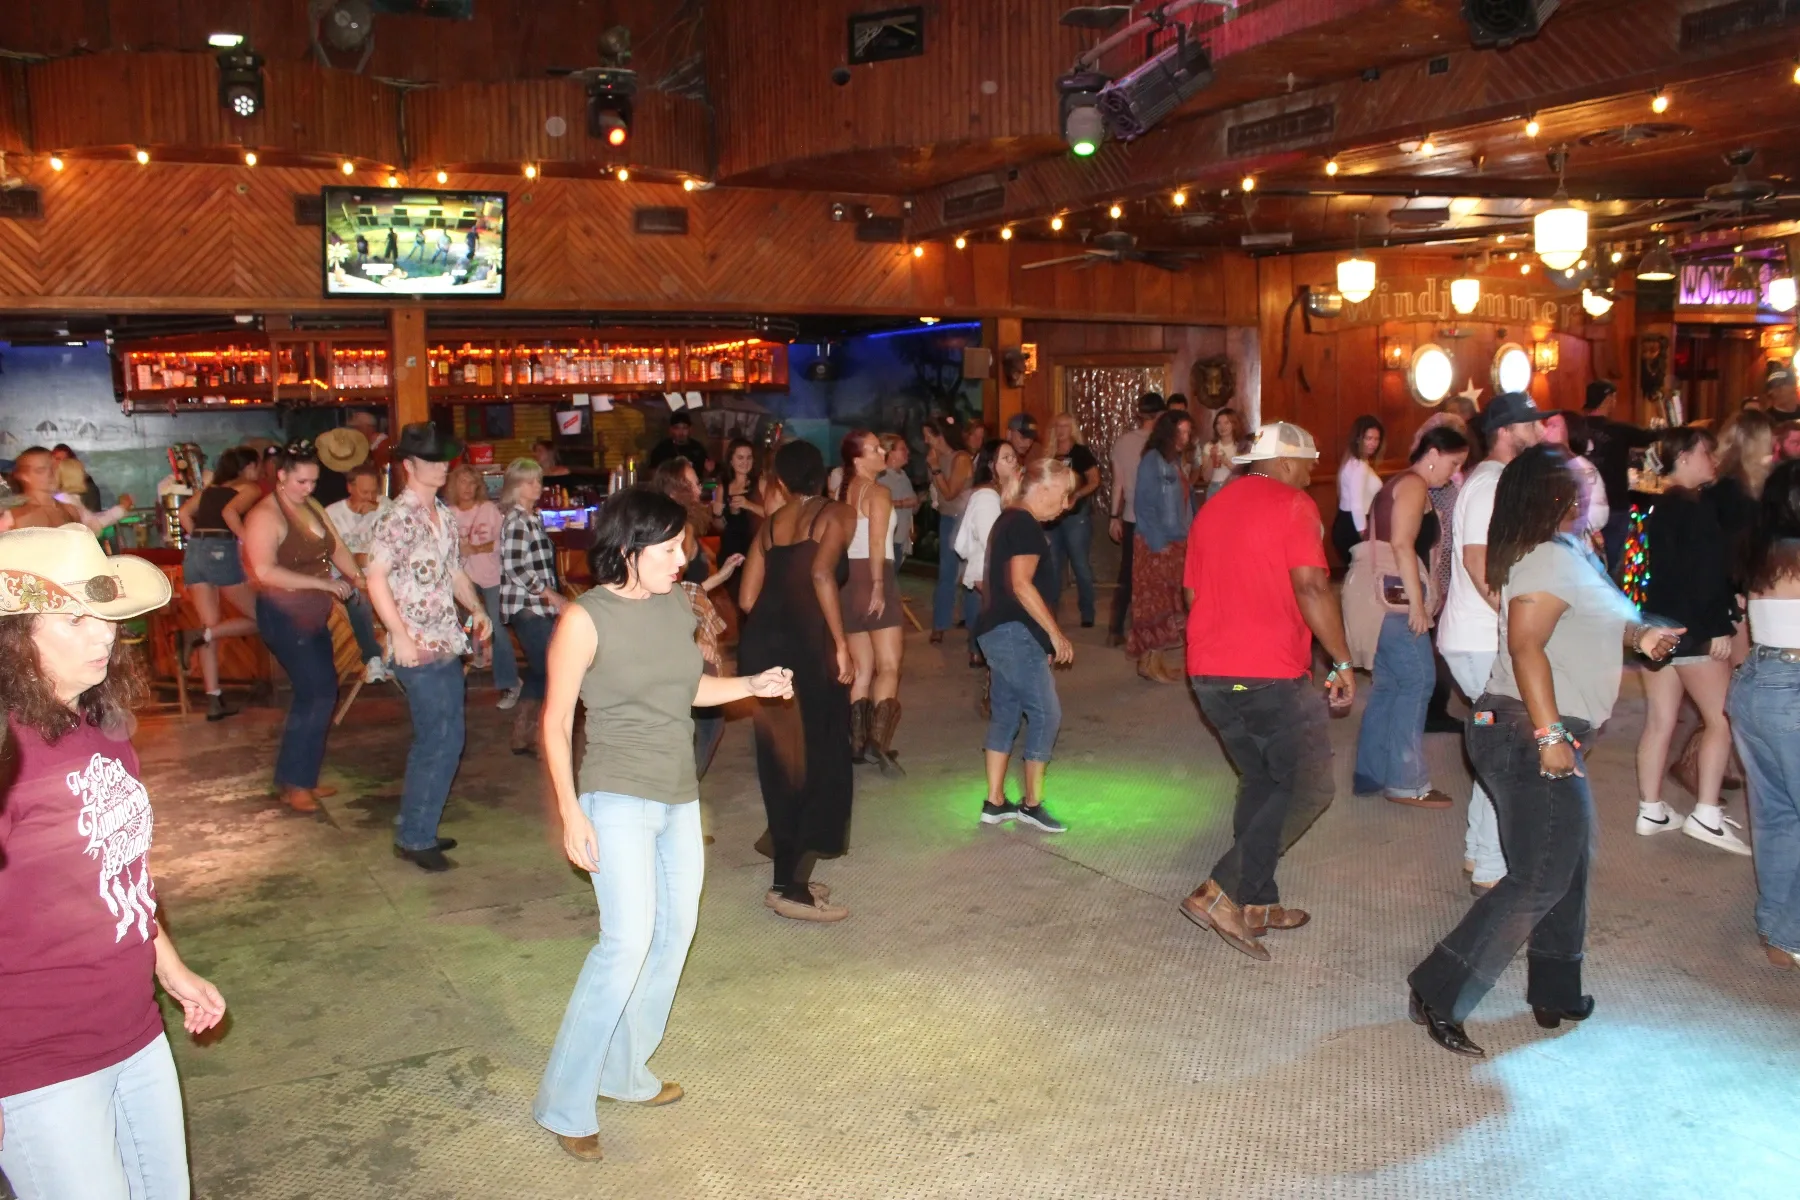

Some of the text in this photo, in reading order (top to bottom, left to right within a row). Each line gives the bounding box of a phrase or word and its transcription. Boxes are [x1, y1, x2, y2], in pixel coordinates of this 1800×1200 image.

[1344, 277, 1582, 329] Windjmmer
[66, 752, 127, 800] The Jess
